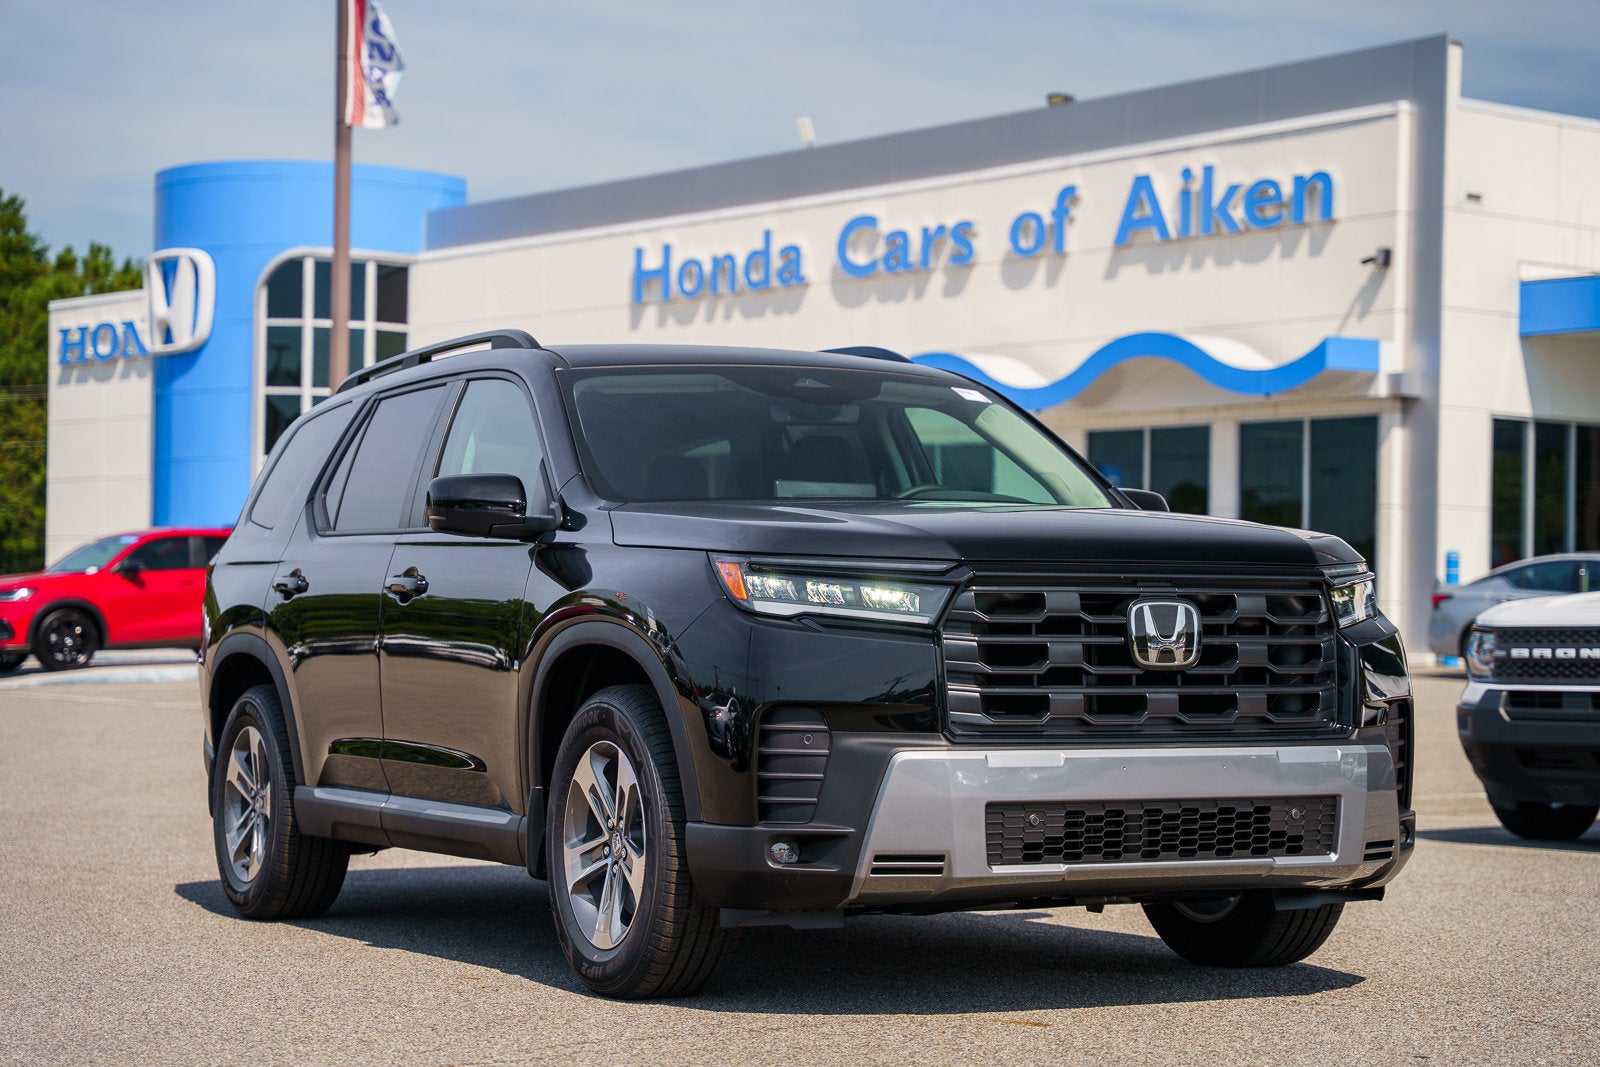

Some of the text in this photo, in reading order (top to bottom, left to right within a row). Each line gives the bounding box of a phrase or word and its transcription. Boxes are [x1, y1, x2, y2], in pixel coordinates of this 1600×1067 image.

[633, 165, 1333, 303] Honda Cars of Aiken
